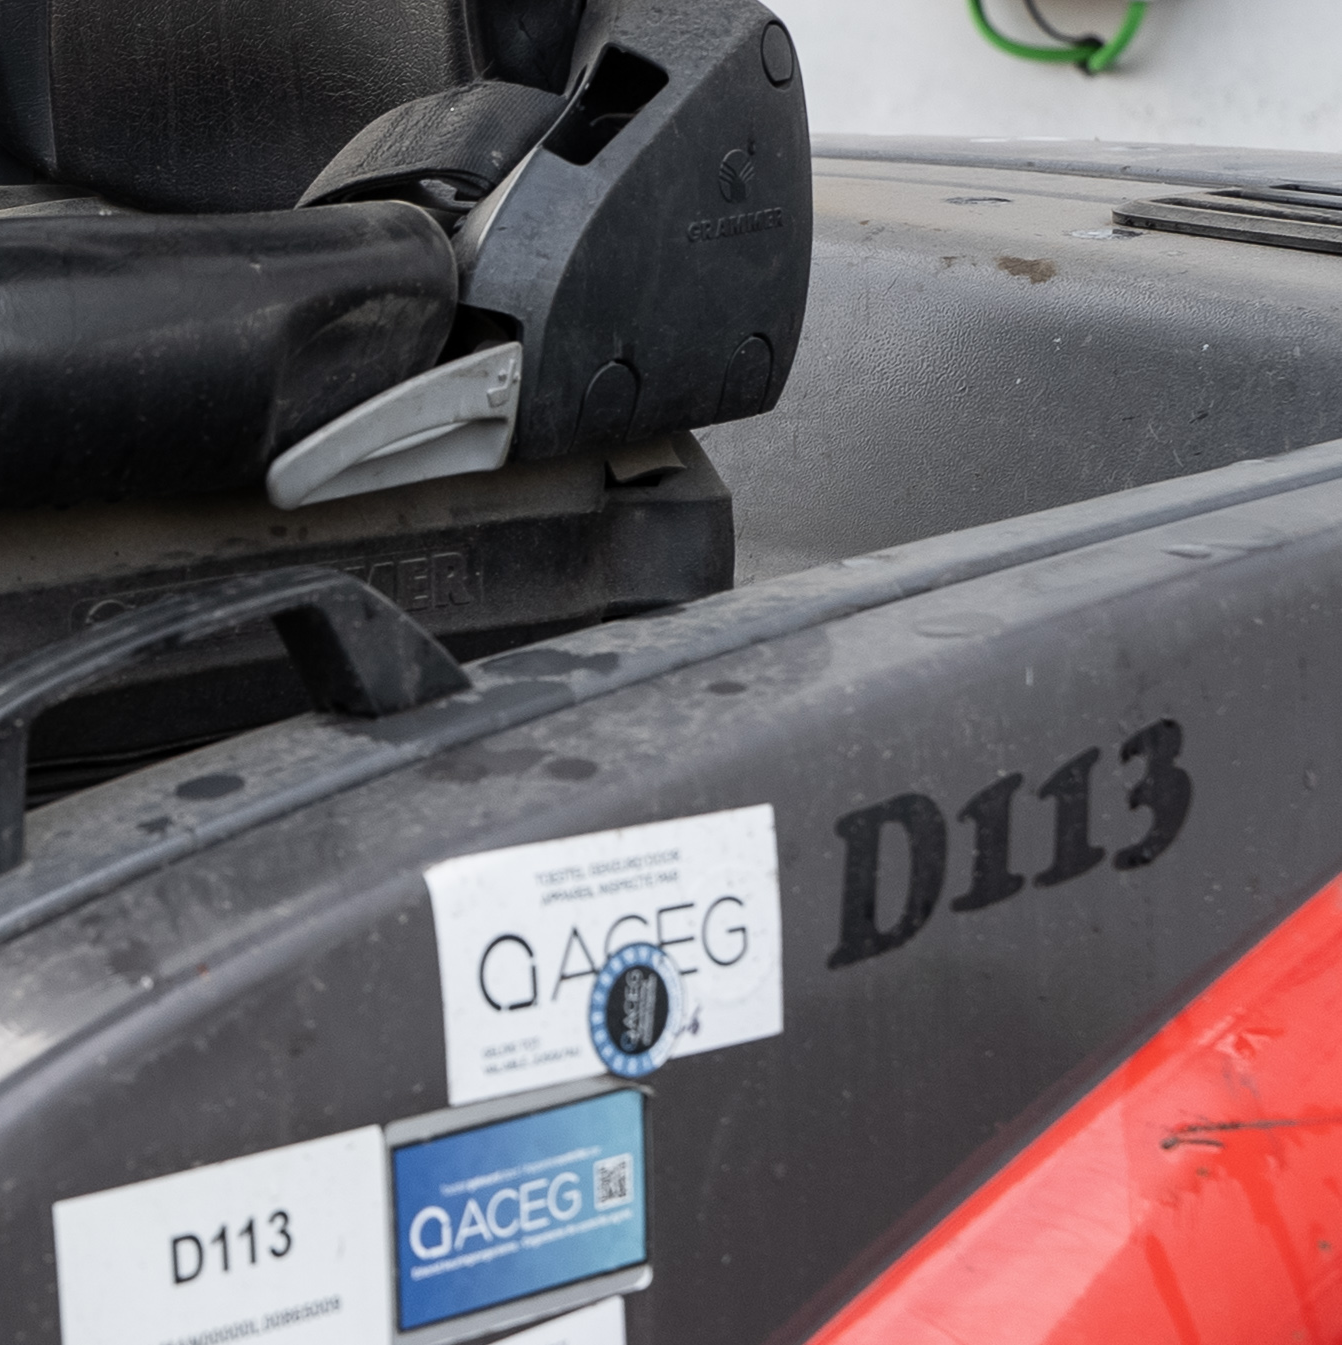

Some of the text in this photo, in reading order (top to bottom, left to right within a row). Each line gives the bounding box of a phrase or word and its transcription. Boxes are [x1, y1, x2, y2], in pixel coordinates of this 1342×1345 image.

[687, 207, 783, 243] GRAMMER
[827, 718, 1192, 970] D113
[171, 1208, 293, 1285] D113
